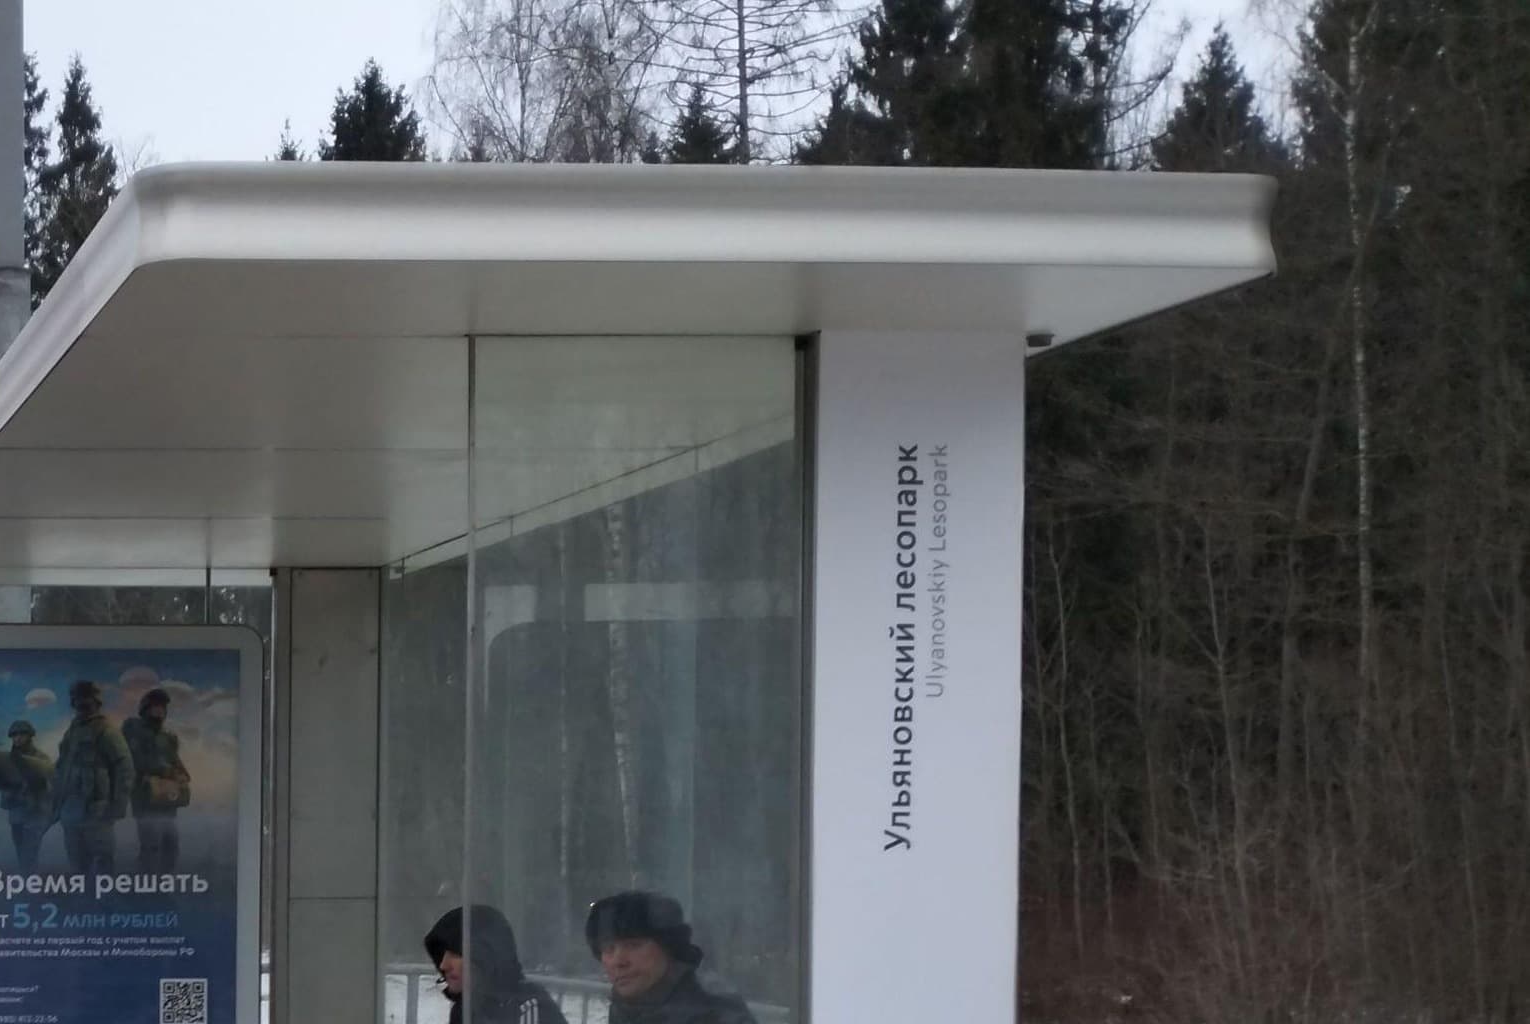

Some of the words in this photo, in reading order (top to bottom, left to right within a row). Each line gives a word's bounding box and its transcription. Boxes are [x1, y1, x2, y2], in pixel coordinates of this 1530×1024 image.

[896, 443, 924, 612] лесопарк
[928, 442, 951, 552] Lesopark
[926, 557, 950, 699] Ulyanovskiy
[884, 622, 916, 852] Ульяновский
[13, 903, 58, 933] 5,2
[62, 913, 106, 928] МЛН
[110, 910, 178, 928] РУБЛЕЙ
[94, 874, 209, 899] решать
